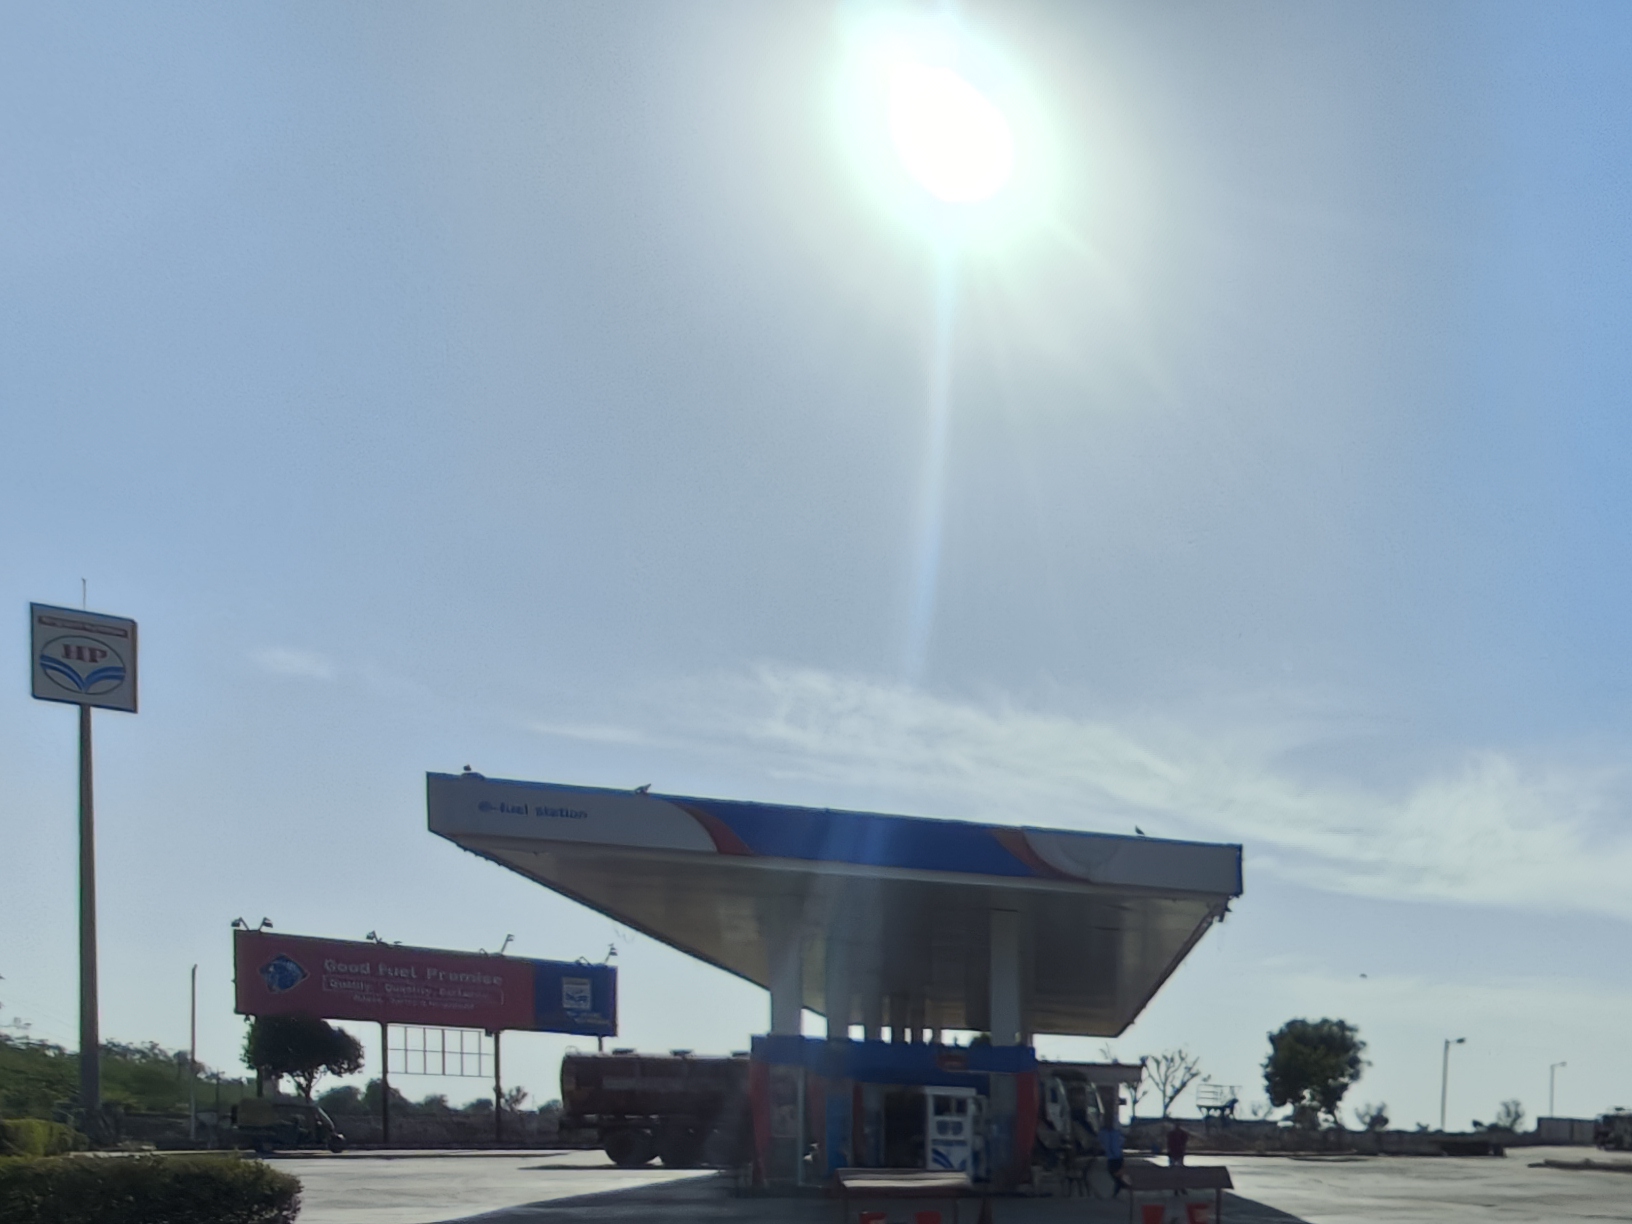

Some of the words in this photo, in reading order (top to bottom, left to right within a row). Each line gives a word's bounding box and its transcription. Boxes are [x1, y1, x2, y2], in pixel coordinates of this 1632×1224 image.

[62, 644, 107, 663] HP
[324, 958, 371, 974] Good
[378, 962, 418, 979] Fuel
[426, 967, 503, 985] Promise
